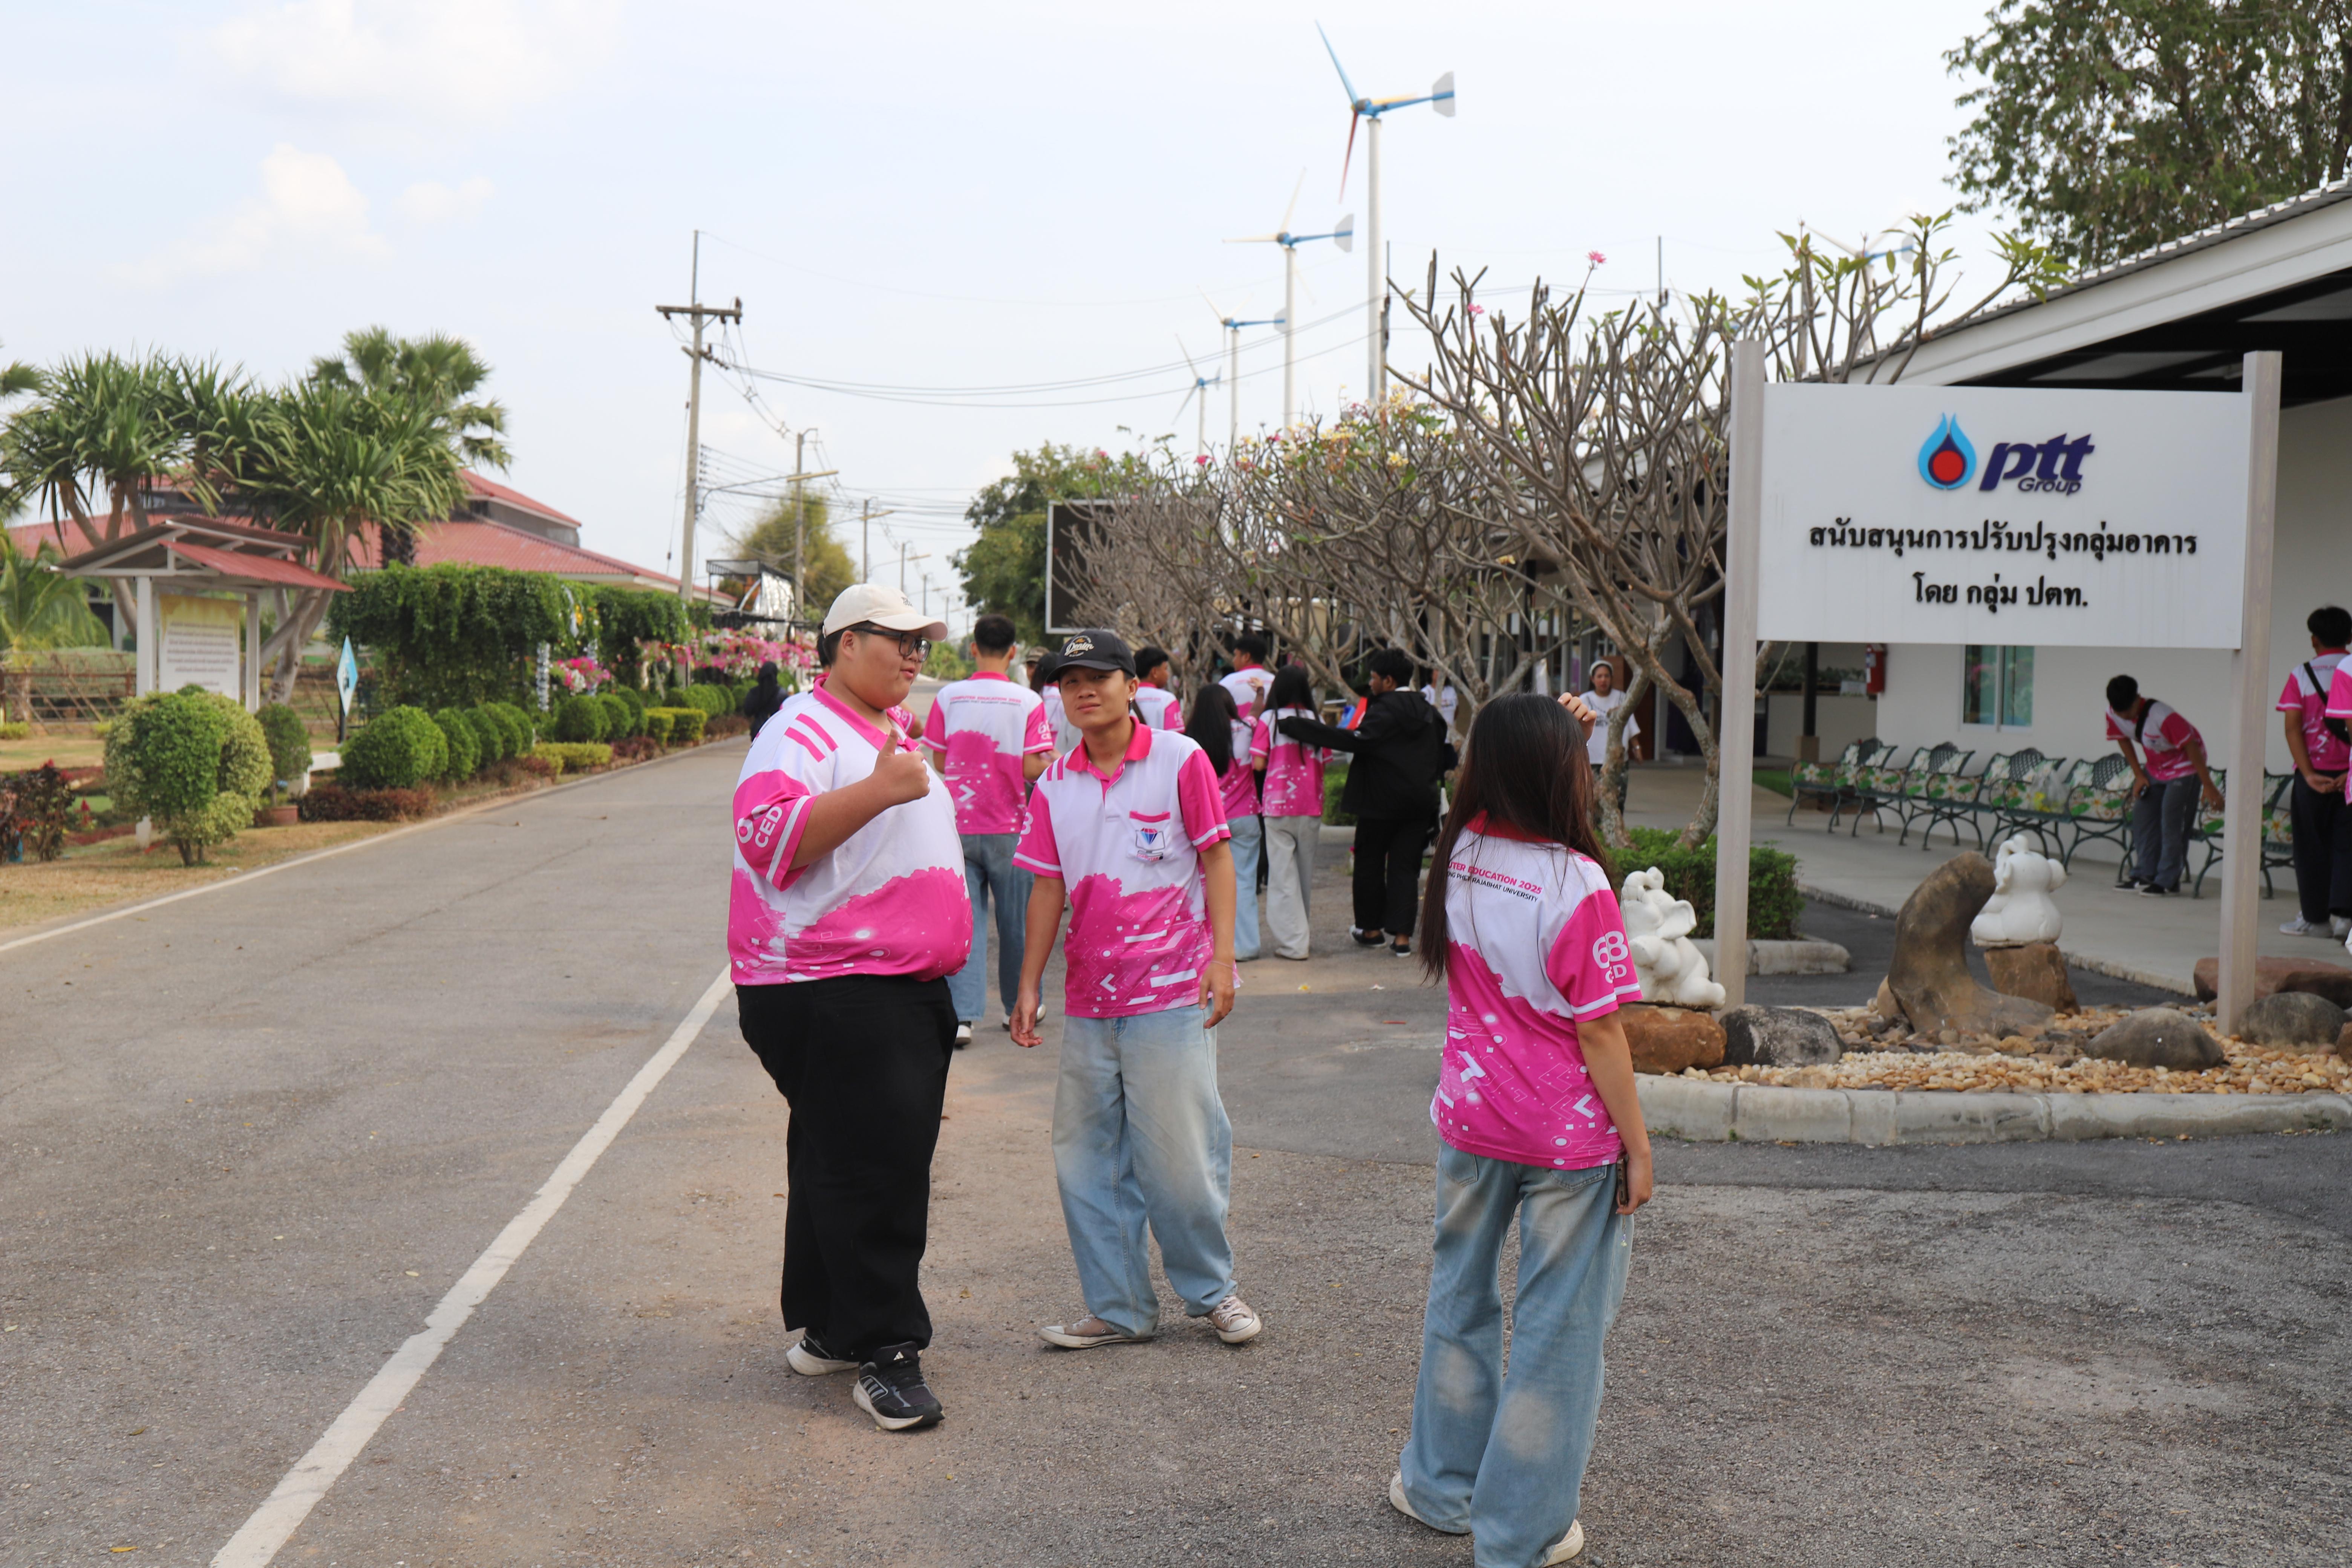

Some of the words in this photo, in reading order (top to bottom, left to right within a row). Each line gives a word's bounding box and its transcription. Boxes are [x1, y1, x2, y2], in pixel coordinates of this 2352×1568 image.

[1979, 433, 2095, 491] ptt
[2018, 477, 2081, 496] Group
[1810, 517, 2197, 561] สนับสนุนการปรับปรุงกลุ่มอาคาร
[1913, 572, 1958, 603] โดย
[1967, 573, 2017, 613] กลุ่ม
[2026, 575, 2088, 606] ปตท.
[755, 806, 782, 847] CED
[1448, 862, 1466, 871] UTER
[1467, 866, 1517, 886] EDUCATION
[1518, 880, 1542, 894] 2025
[1472, 877, 1501, 890] RAJABHAT
[1502, 886, 1538, 903] UNIVERSITY
[1592, 930, 1628, 969] 68
[1605, 964, 1628, 984] CD
